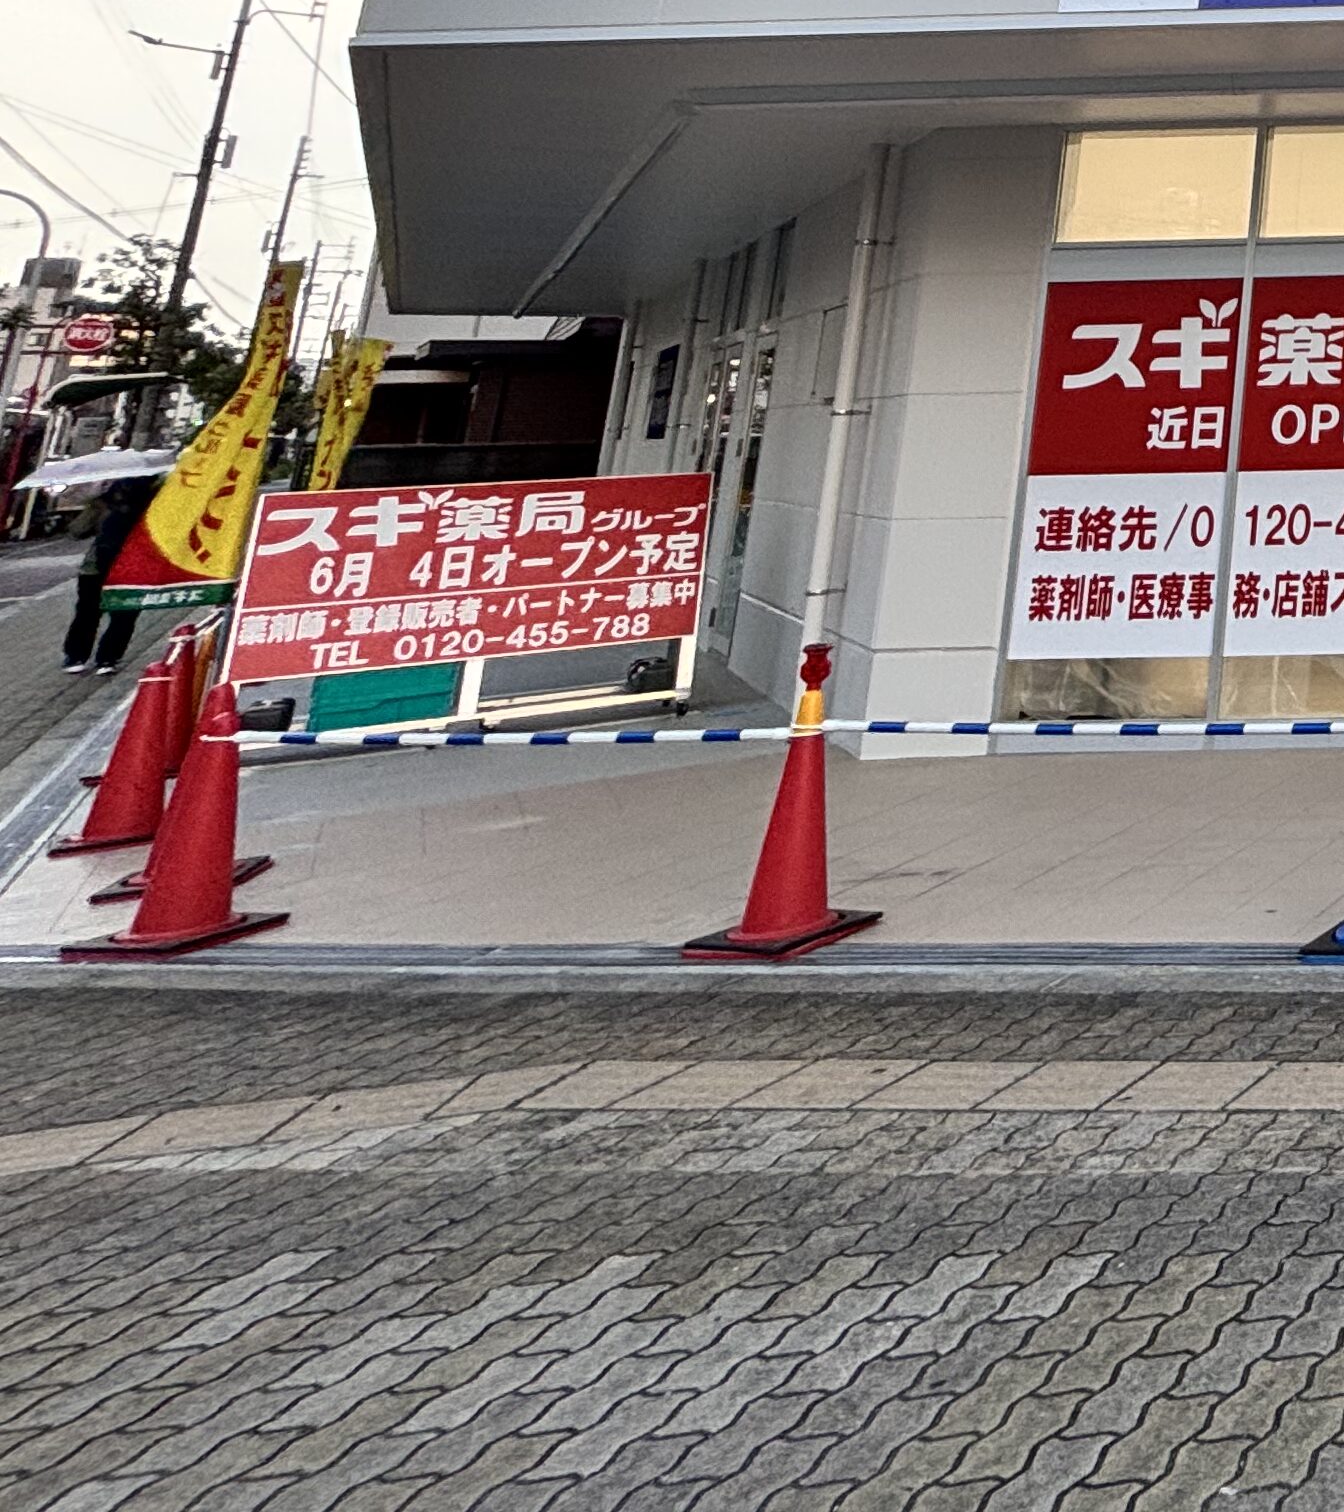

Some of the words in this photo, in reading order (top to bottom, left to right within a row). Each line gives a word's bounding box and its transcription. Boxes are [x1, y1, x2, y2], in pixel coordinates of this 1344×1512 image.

[1146, 406, 1224, 449] 近日
[257, 489, 586, 556] スギ薬局
[591, 503, 707, 533] グループ
[309, 551, 374, 598] 6月
[409, 531, 700, 590] 4日オープン予定
[310, 640, 369, 669] TEL
[394, 613, 650, 660] 0120-455-788
